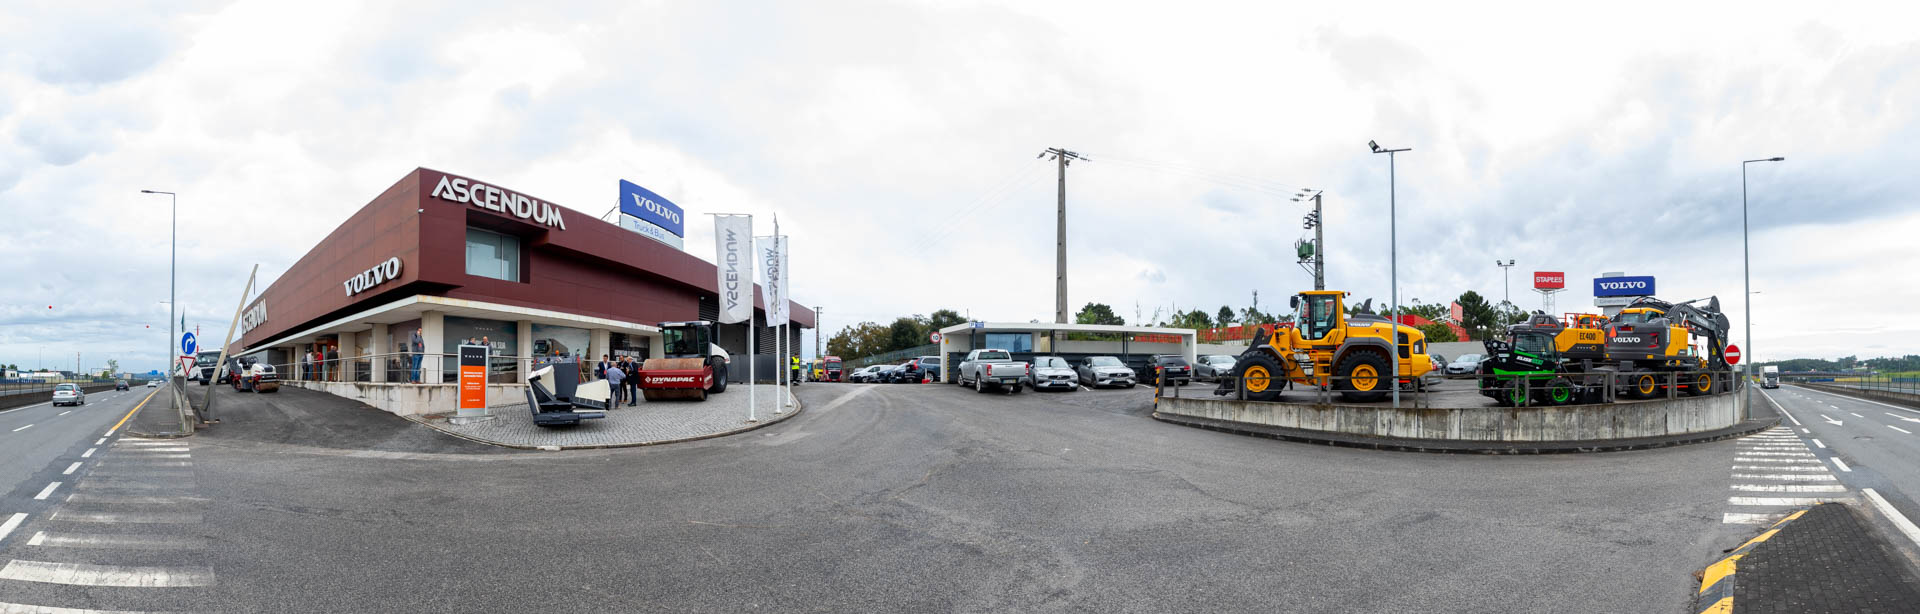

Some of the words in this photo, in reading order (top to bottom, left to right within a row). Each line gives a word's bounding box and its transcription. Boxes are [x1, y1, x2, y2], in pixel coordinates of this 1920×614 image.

[431, 175, 566, 230] ASCENDUM
[631, 192, 680, 224] VOLVO
[344, 257, 402, 296] VOLVO
[1600, 281, 1647, 290] VOLVO
[1580, 332, 1596, 341] EC400
